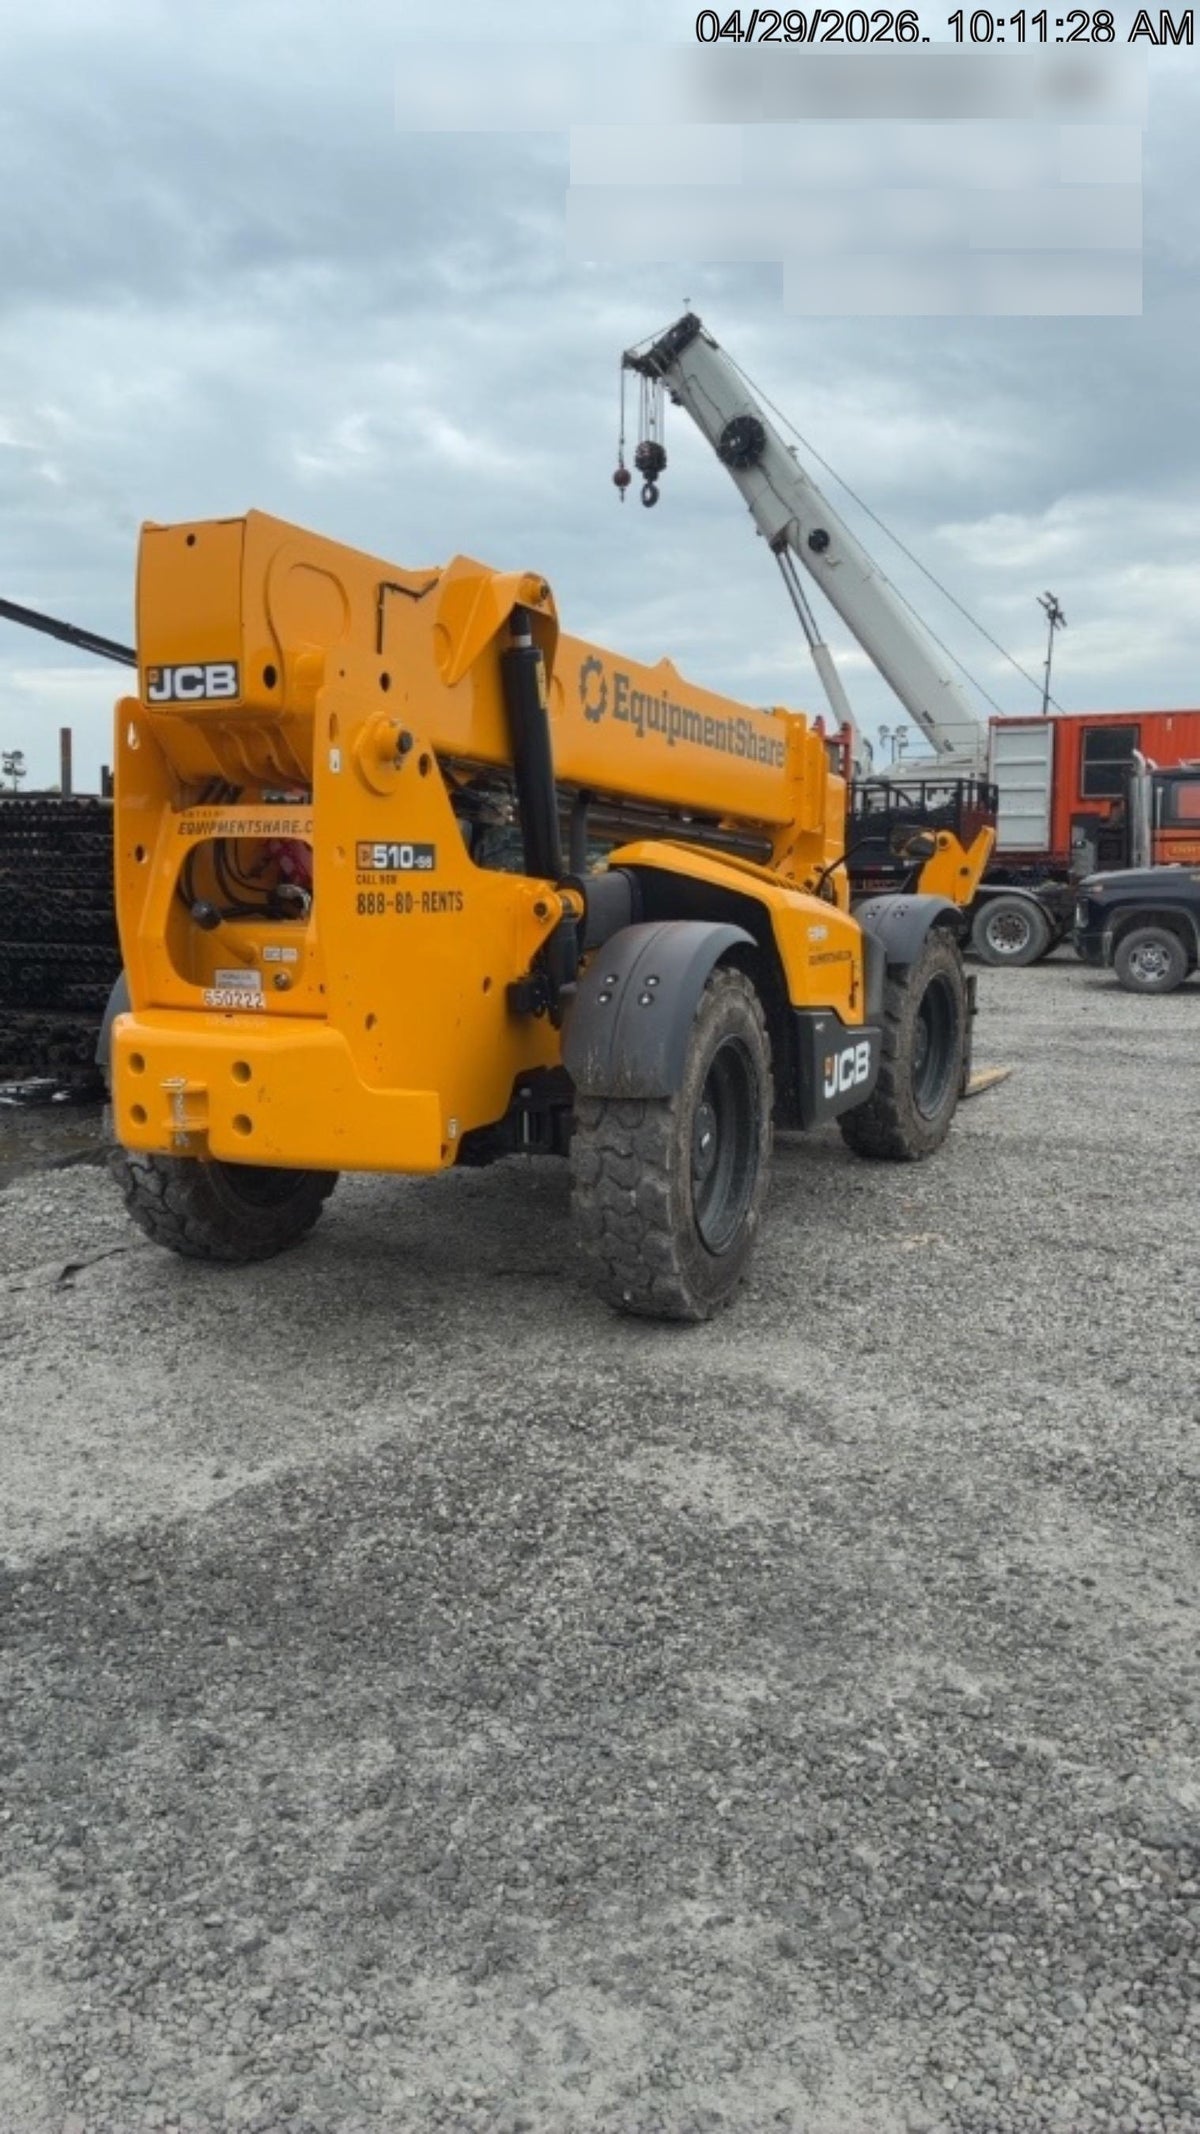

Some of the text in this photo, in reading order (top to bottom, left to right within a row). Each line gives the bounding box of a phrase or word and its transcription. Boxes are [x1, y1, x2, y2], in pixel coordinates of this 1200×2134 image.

[148, 664, 236, 700] JCB
[613, 671, 785, 768] EquipmentShare
[356, 874, 397, 885] CALL NOW
[357, 890, 464, 916] 888-80-RENTS
[824, 1041, 870, 1098] JCB
